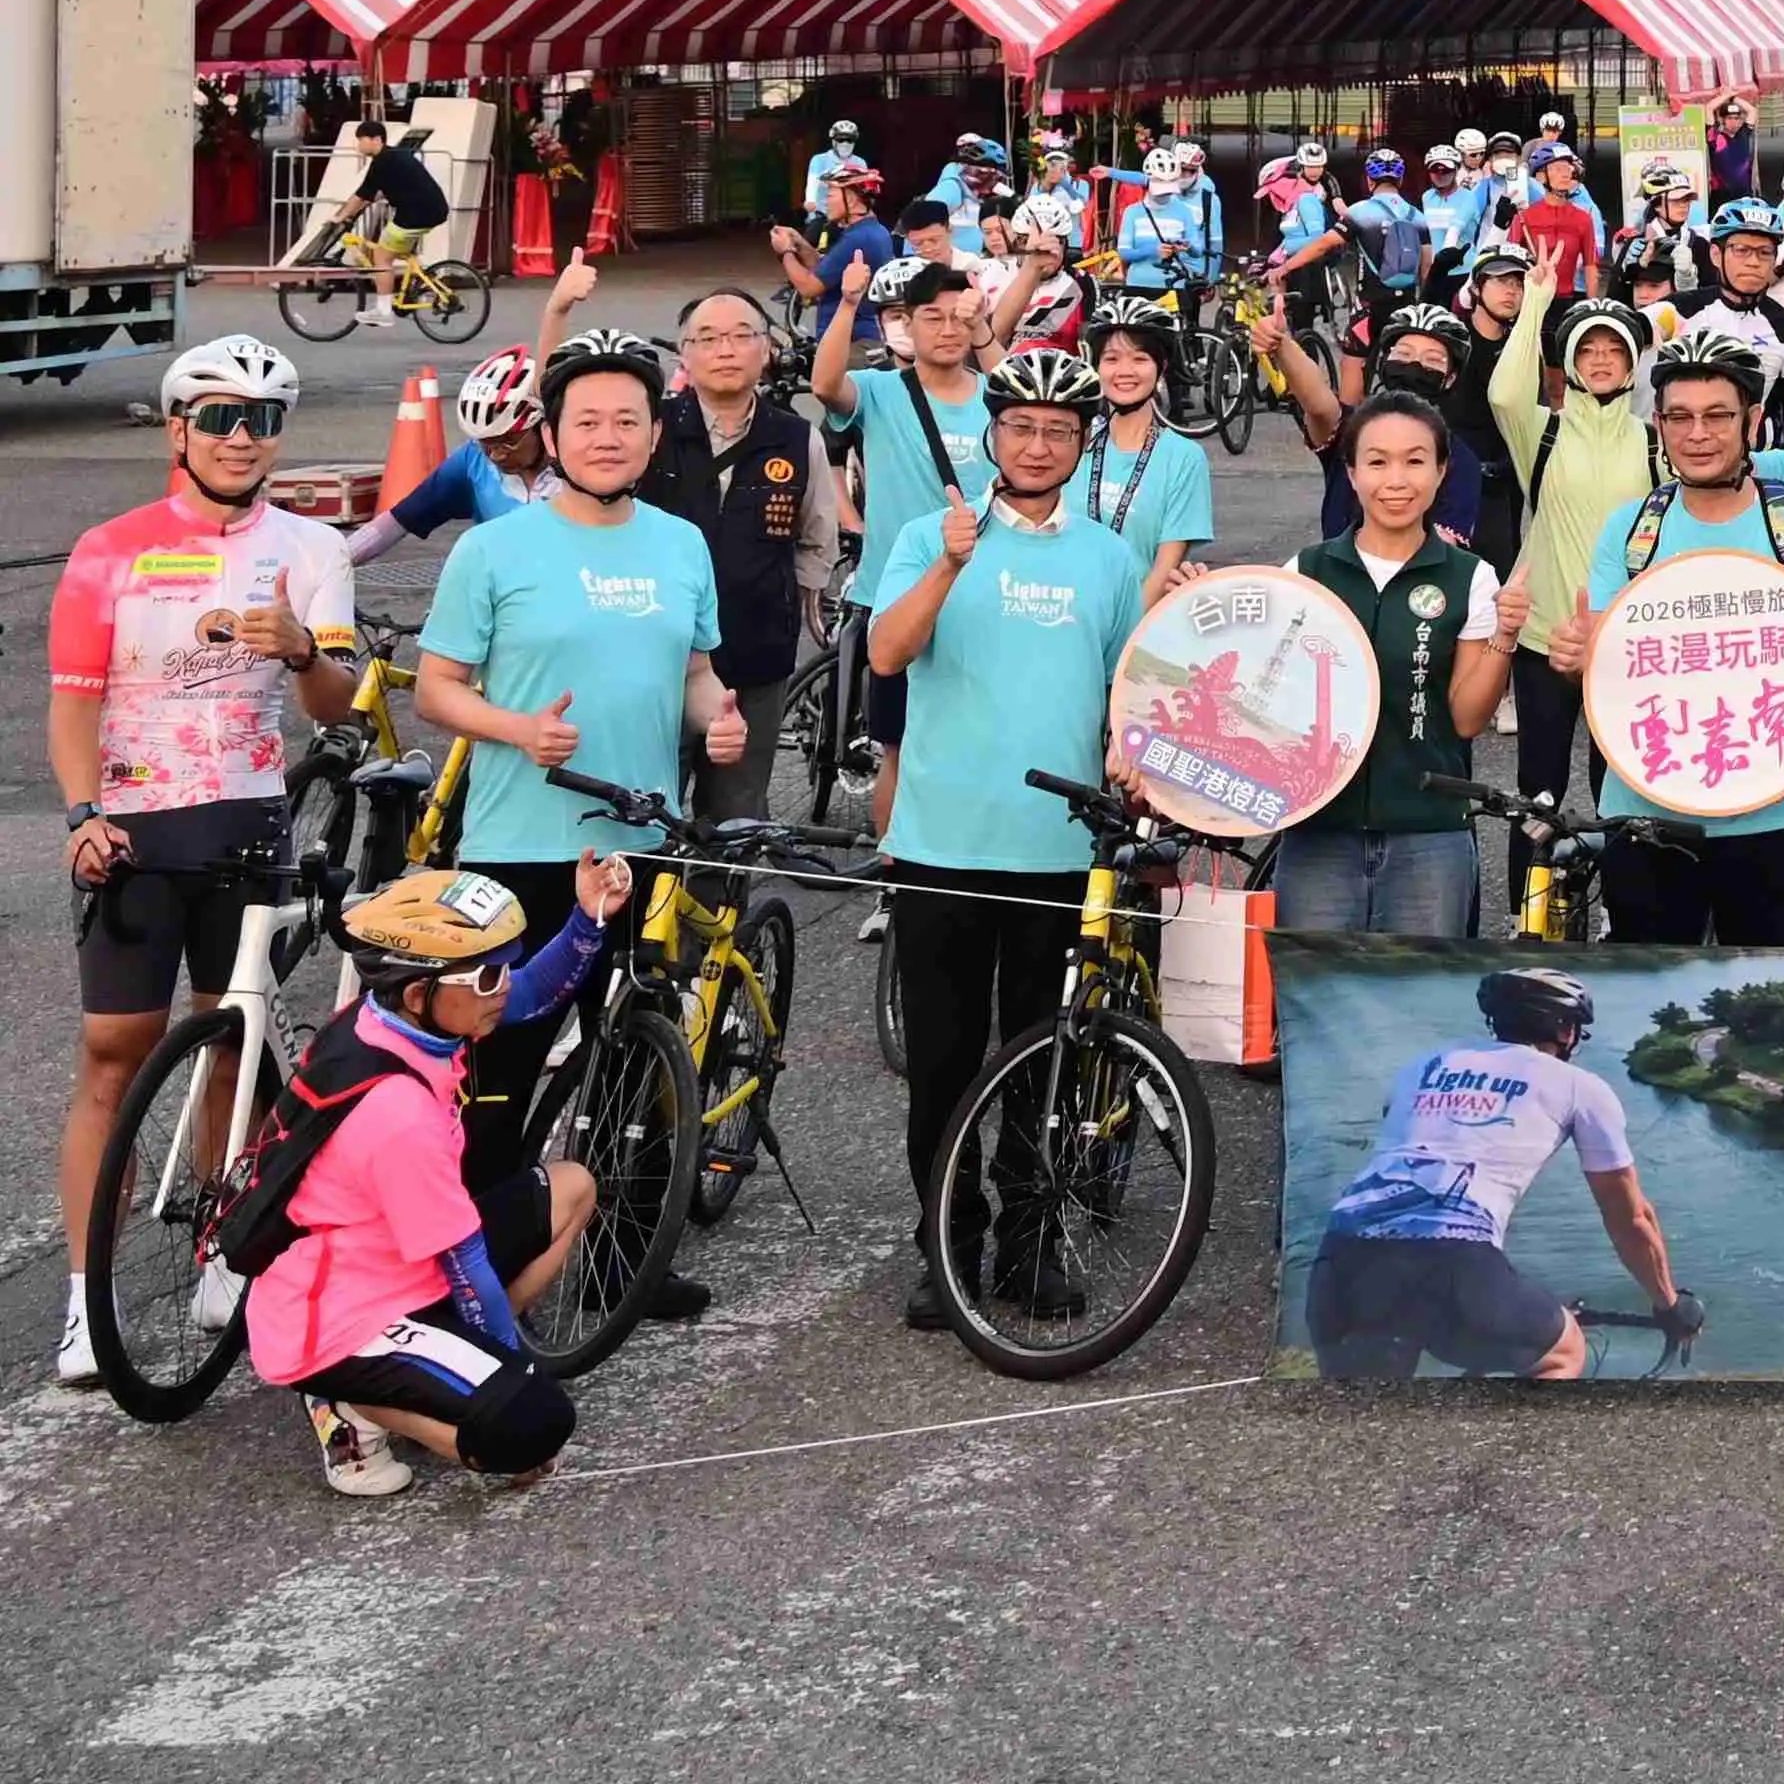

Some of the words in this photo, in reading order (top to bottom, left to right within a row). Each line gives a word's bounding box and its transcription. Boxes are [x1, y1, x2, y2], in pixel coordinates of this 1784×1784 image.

[999, 569, 1050, 600] Light
[1051, 585, 1075, 600] up
[1001, 600, 1061, 614] TAIWAN
[1188, 585, 1267, 634] 台南
[1409, 622, 1433, 742] 台南市議員
[1141, 738, 1285, 826] 國聖港燈塔
[1419, 1054, 1489, 1093] Light
[1490, 1073, 1529, 1100] up
[1413, 1091, 1498, 1112] TAIWAN
